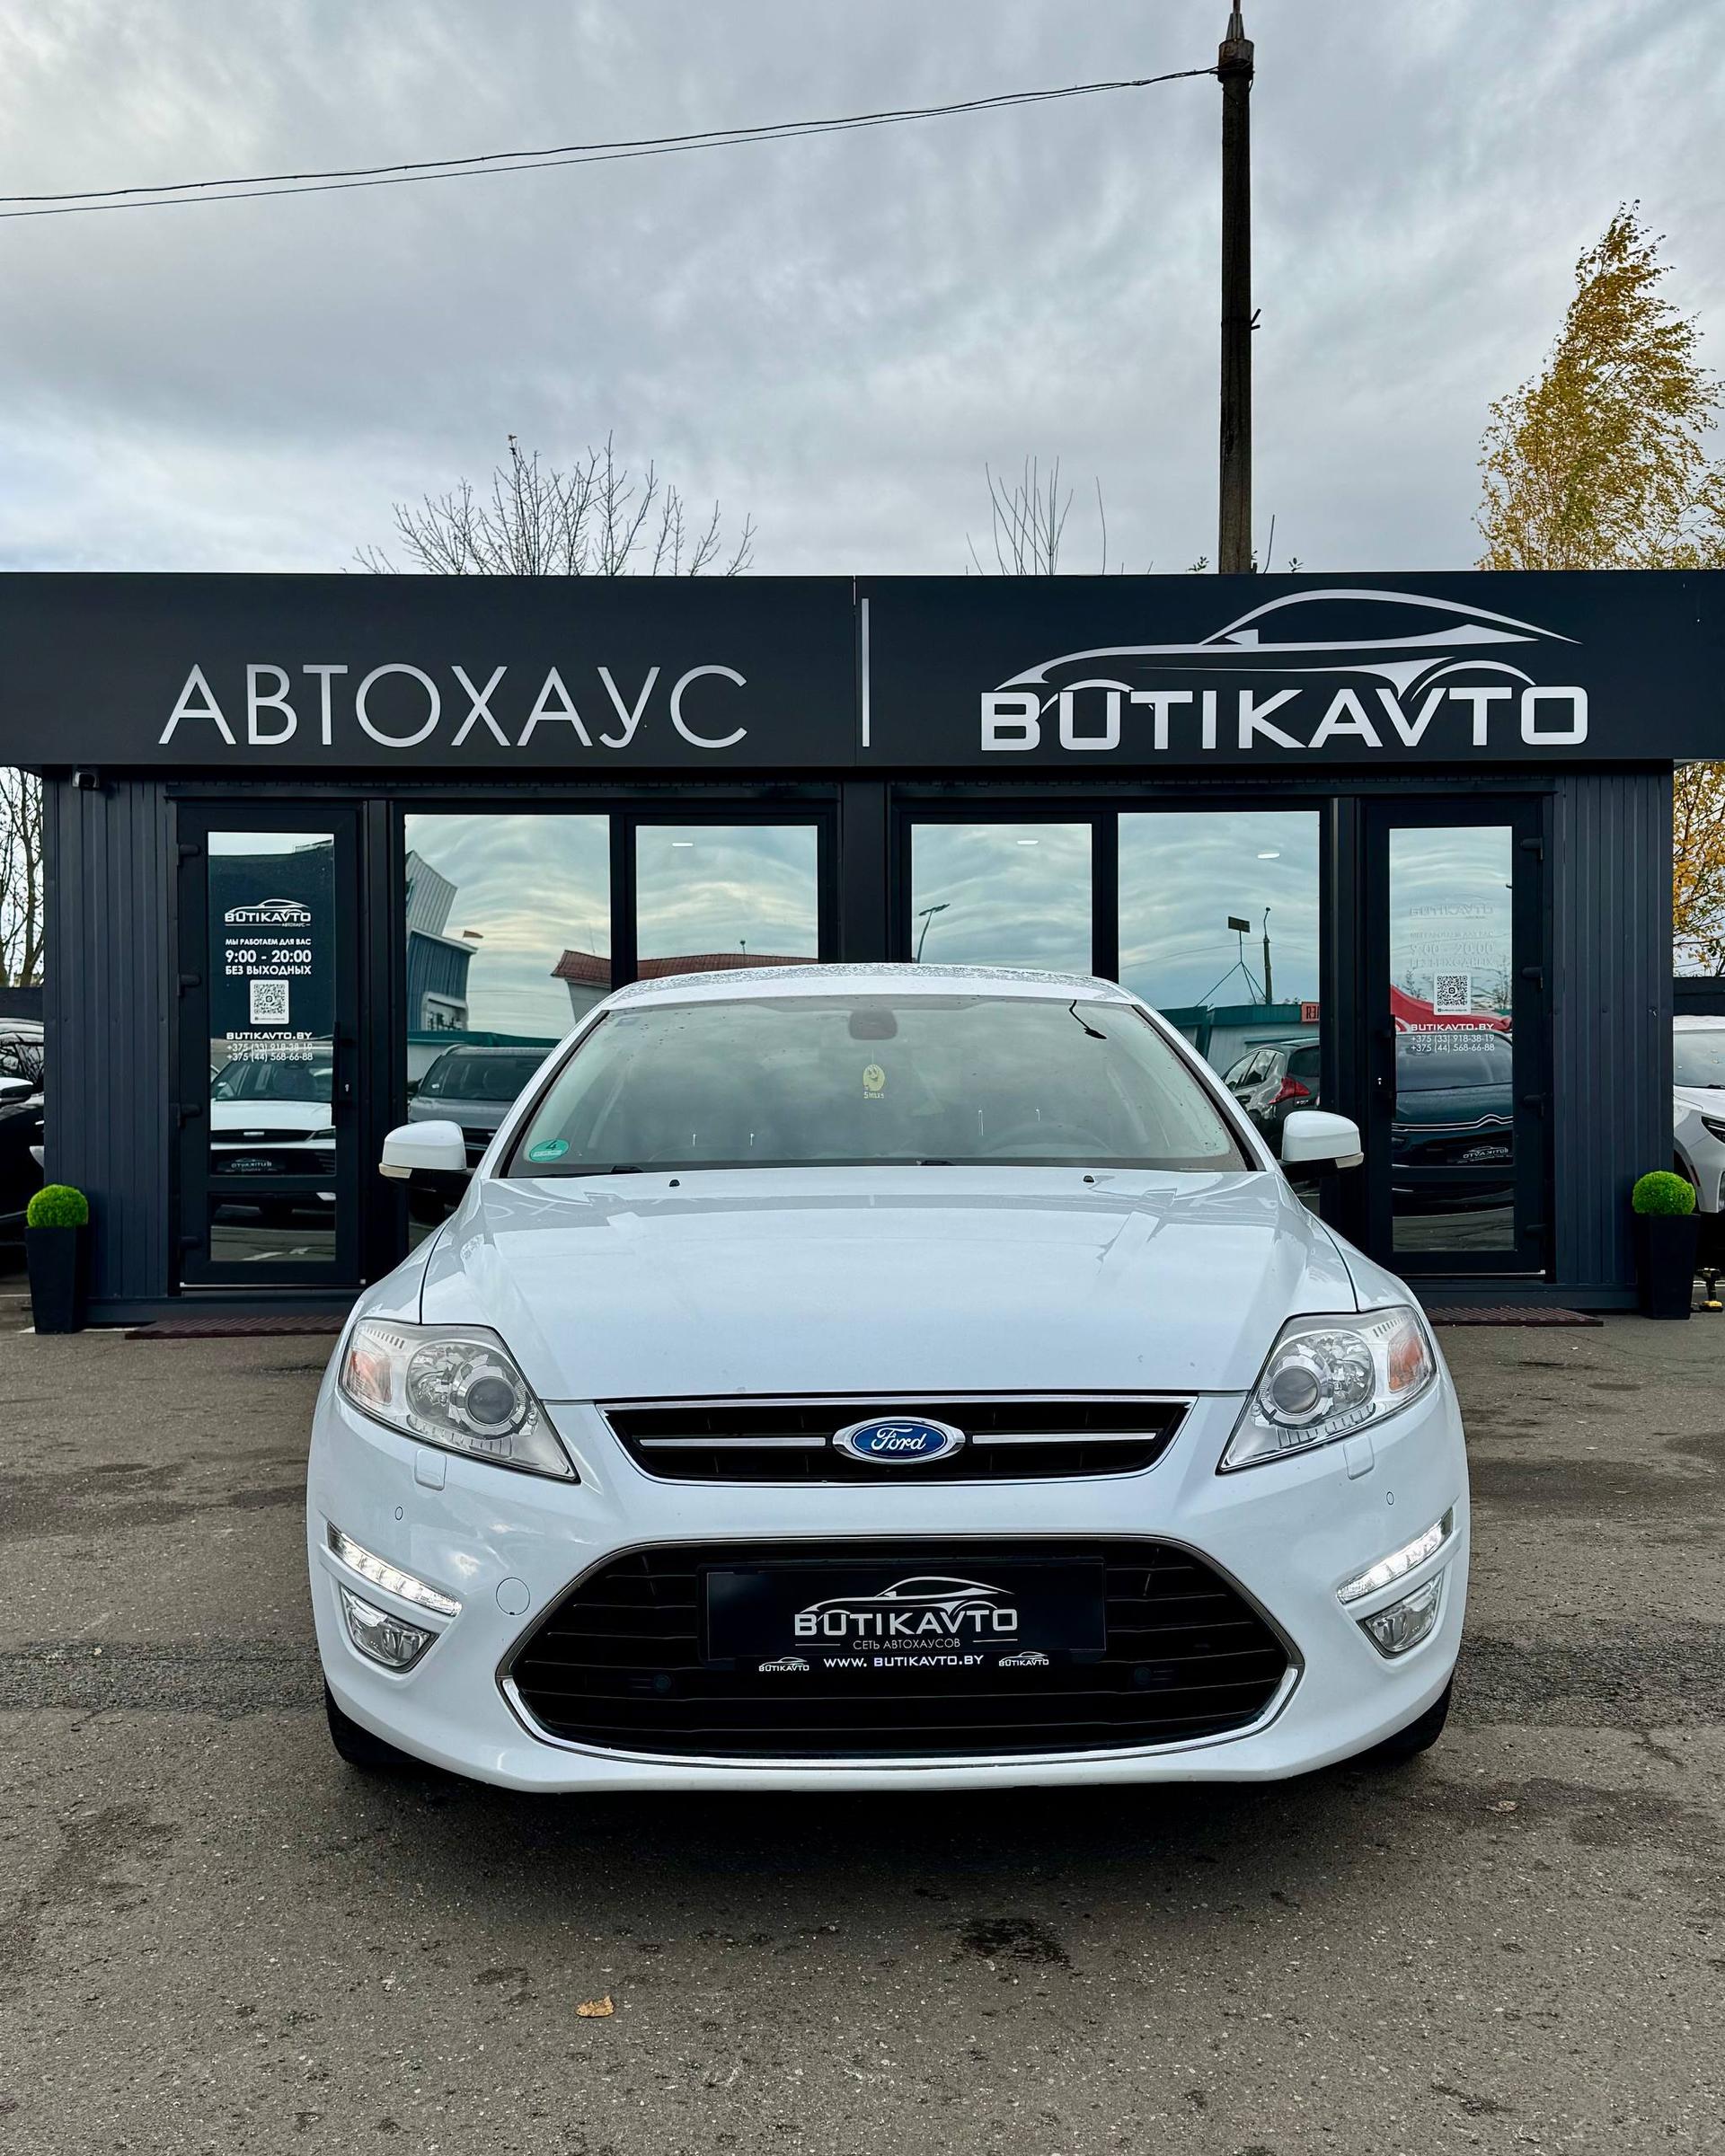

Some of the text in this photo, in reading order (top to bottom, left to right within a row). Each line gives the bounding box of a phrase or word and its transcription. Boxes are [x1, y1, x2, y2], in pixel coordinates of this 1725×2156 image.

[159, 664, 747, 747] АВТОХАУС
[981, 685, 1588, 750] BUTIKAVTO
[225, 912, 311, 922] BUTIKAVTO
[226, 950, 257, 962] 9:00
[271, 950, 312, 962] 20:00
[226, 966, 312, 976] БЕЗ ВЫХОДНЫХ
[1434, 1034, 1450, 1044] (33)
[252, 1043, 268, 1053] (33)
[1434, 1043, 1450, 1053] (44)
[227, 1052, 314, 1063] +375 (44) 568-66-88
[871, 1427, 927, 1450] Ford
[794, 1609, 1018, 1636] BUTIKAVTO
[853, 1638, 961, 1650] СЕТЬ АВТОХАУСОВ
[823, 1655, 985, 1667] WWW. BUTIKAVTO.BY
[998, 1658, 1049, 1667] BUTIKAVTO
[758, 1663, 809, 1672] BUTIKAVTO
